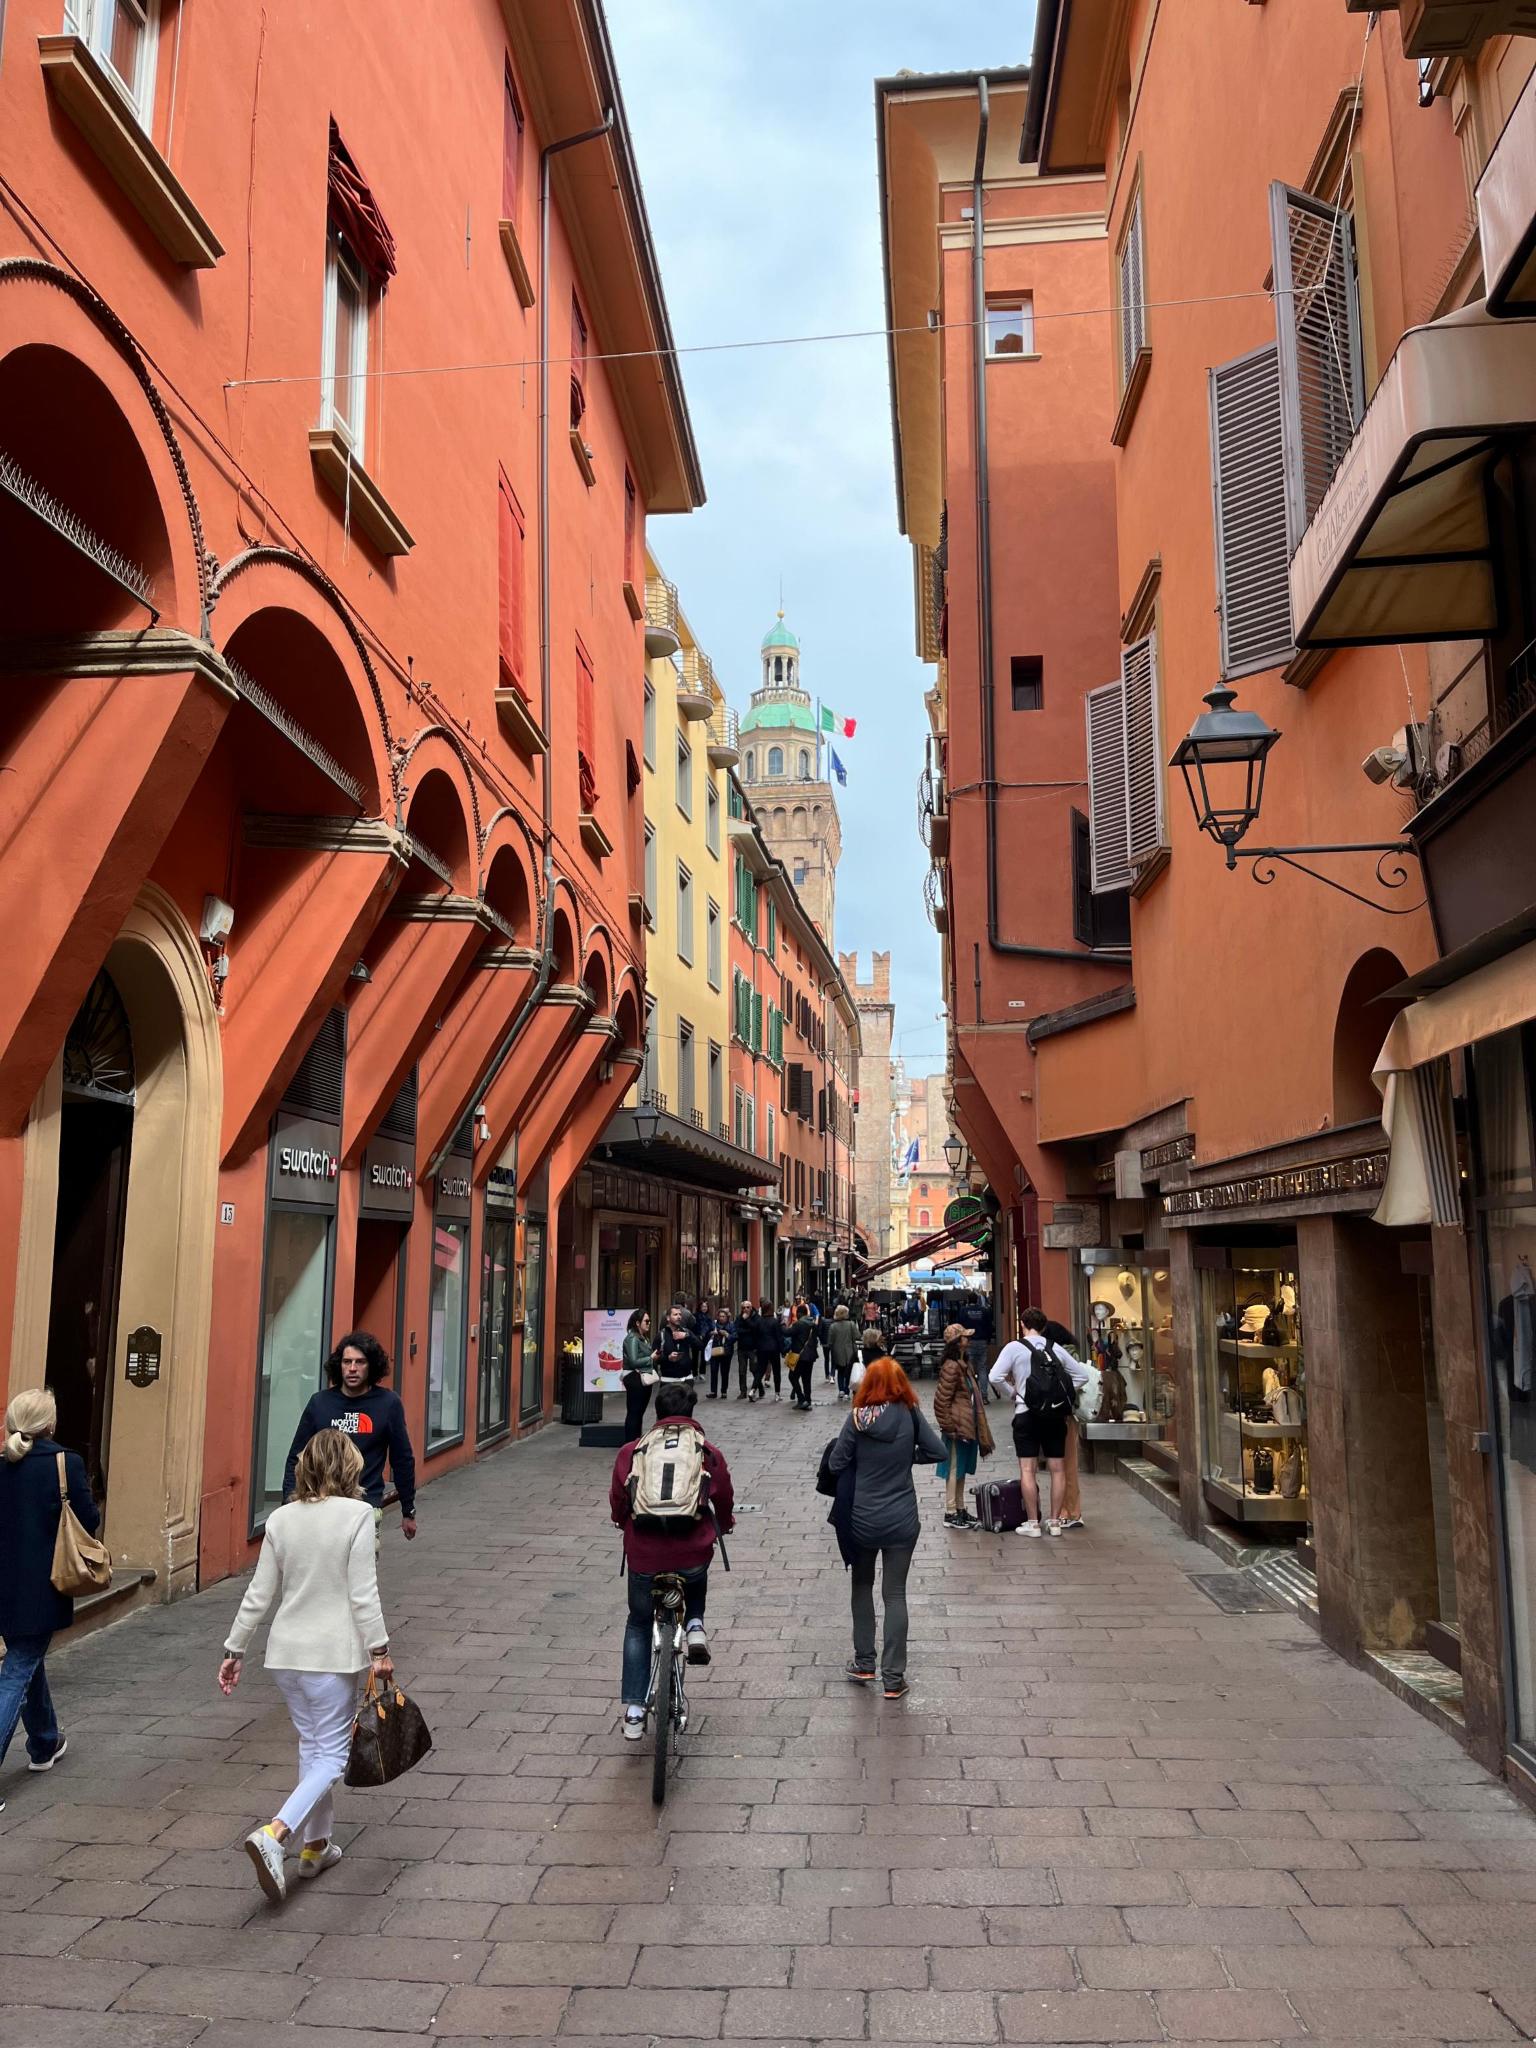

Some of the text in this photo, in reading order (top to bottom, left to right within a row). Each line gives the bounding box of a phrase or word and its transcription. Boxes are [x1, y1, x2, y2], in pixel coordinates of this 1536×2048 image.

[281, 1147, 330, 1177] swatch
[372, 1163, 408, 1189] swatch
[442, 1177, 468, 1197] swatch
[331, 1419, 359, 1427] NORTH
[344, 1412, 360, 1420] THE
[338, 1426, 359, 1434] FACE
